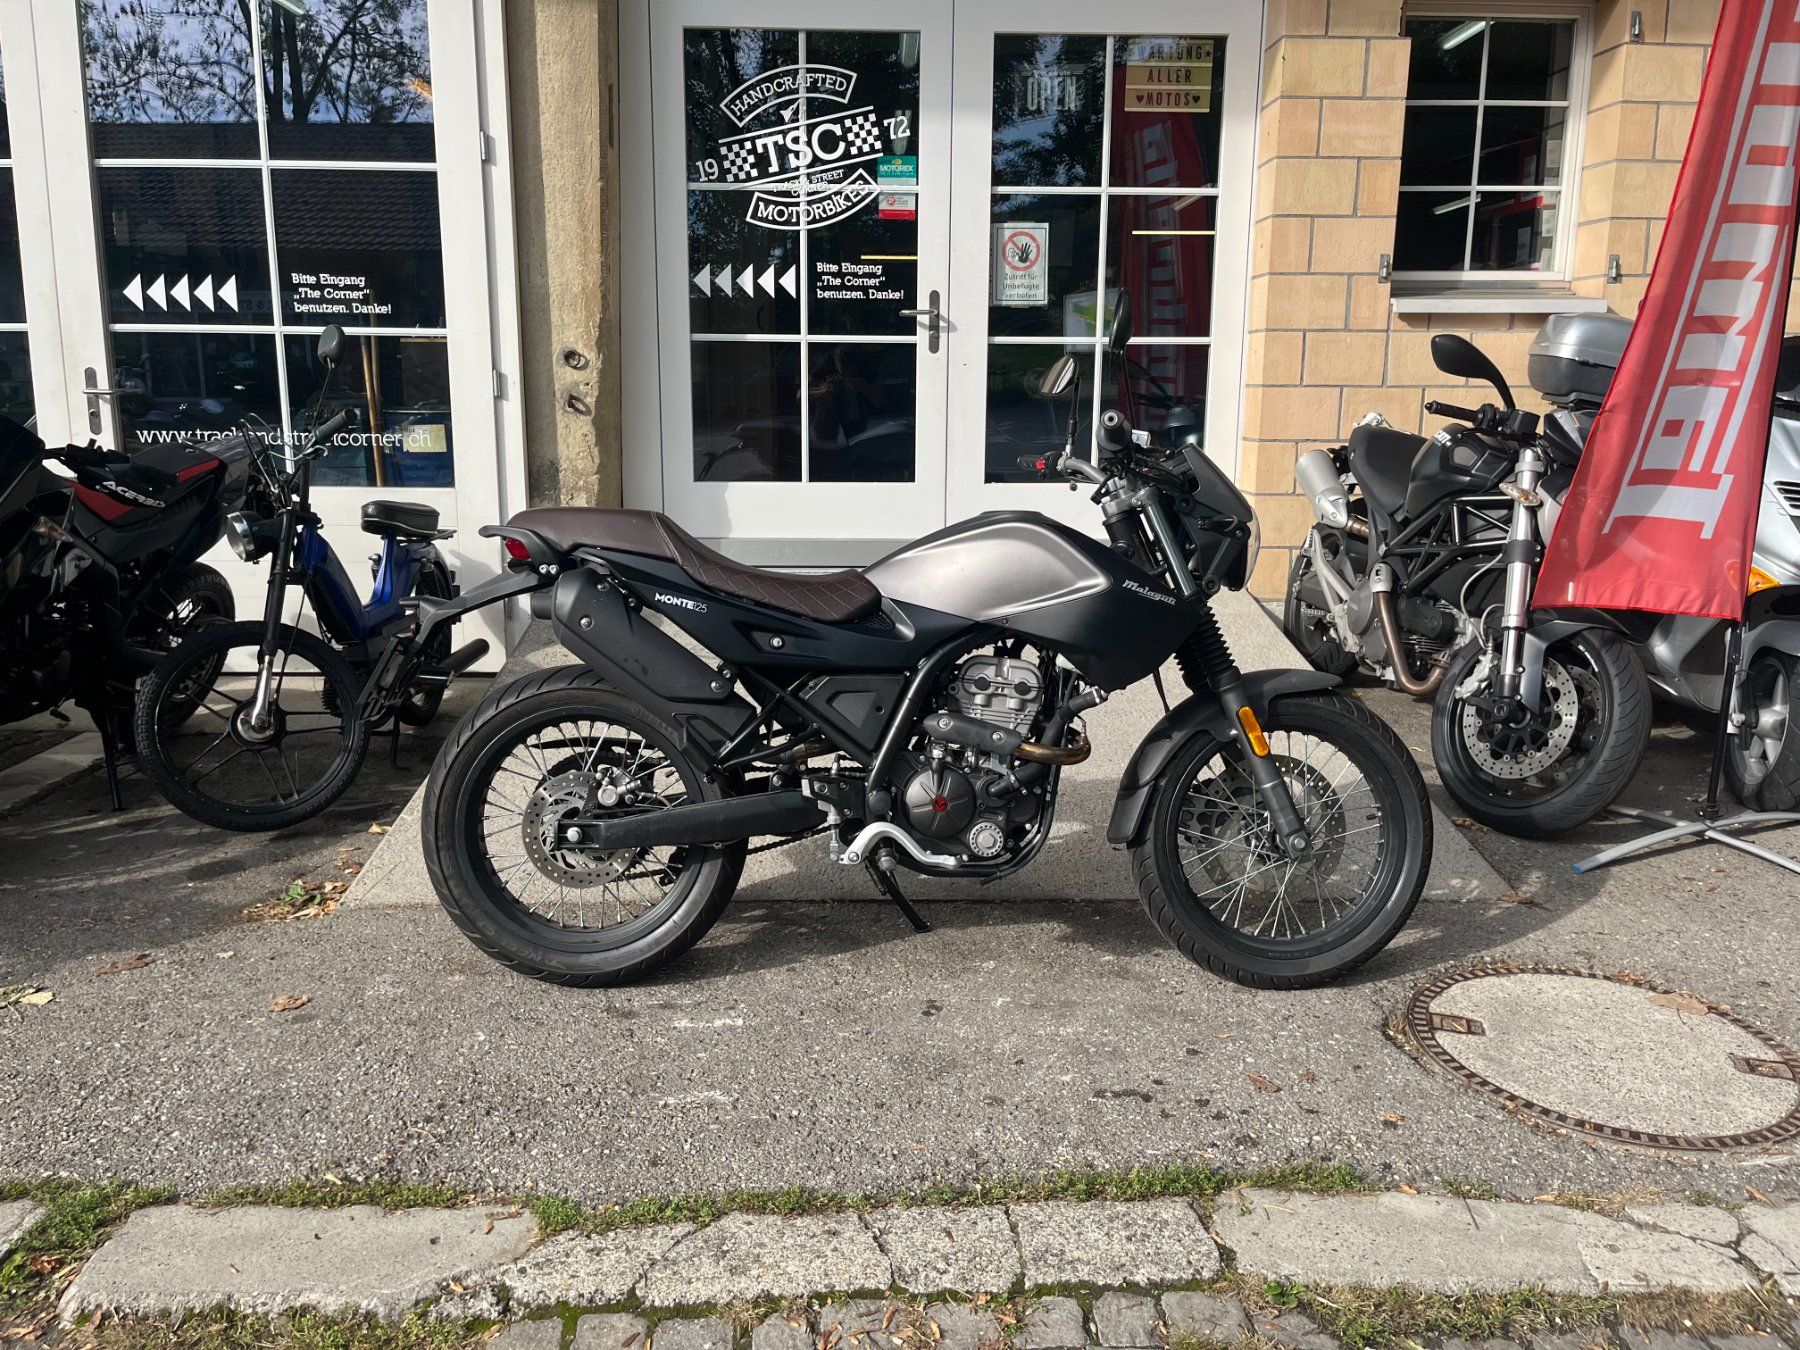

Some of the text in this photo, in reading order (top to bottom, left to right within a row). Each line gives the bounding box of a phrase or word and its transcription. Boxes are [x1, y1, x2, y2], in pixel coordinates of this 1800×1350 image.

[1147, 69, 1192, 83] ALLER
[730, 73, 847, 116] HANDCRAFTED
[1027, 76, 1076, 110] OPEN
[1145, 92, 1190, 106] MOTOS
[883, 115, 911, 140] 72
[755, 123, 846, 173] TSC
[695, 158, 719, 182] 19
[880, 164, 914, 172] MOTOREX
[811, 169, 844, 185] STREET
[757, 180, 871, 222] MOTORBIKES
[816, 262, 883, 275] Bitte Eingang
[291, 273, 365, 287] Bitte Eingang
[1002, 283, 1040, 291] Unbefugte
[816, 288, 904, 300] benutzen. Danke!
[293, 302, 392, 315] benutzen. Danke!
